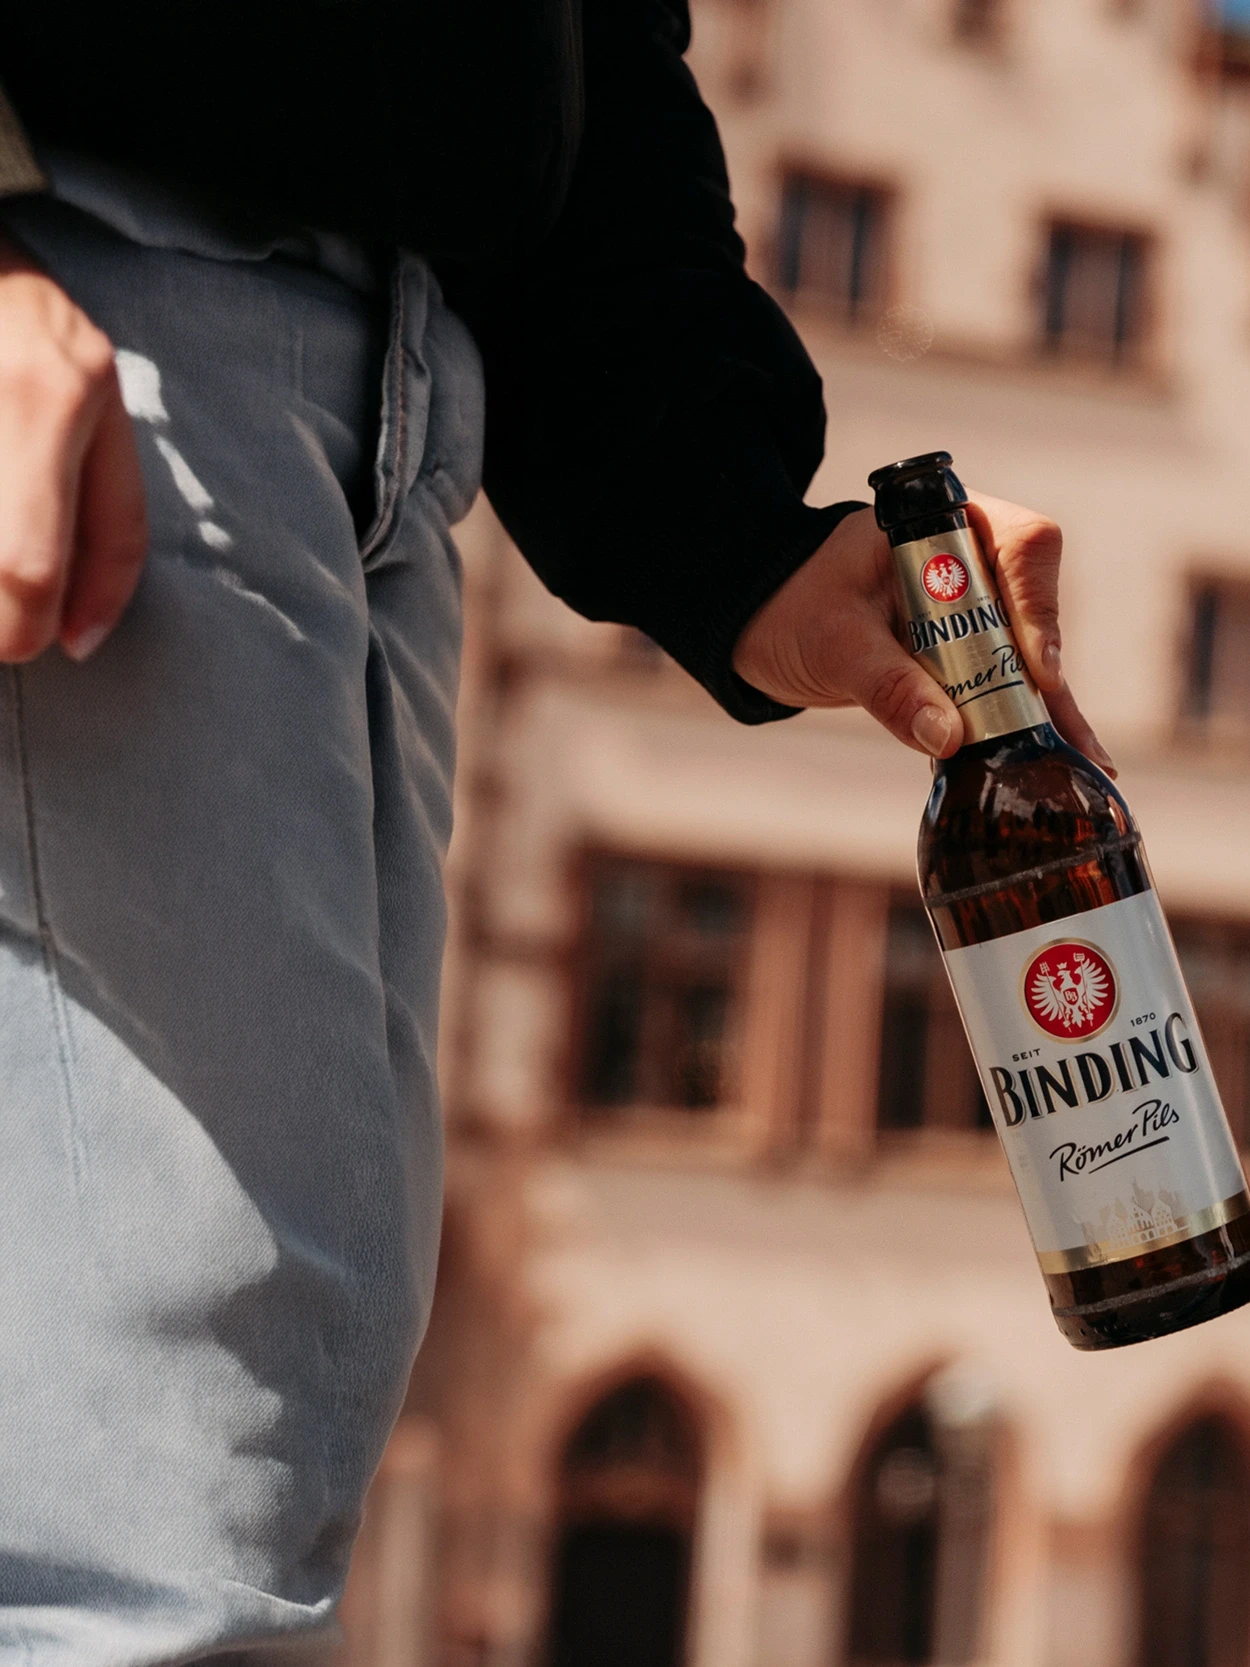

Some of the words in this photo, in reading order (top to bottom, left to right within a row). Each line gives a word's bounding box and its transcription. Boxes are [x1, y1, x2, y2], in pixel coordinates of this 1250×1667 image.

[992, 644, 1027, 678] Pil
[989, 1012, 1200, 1128] BINDING
[1012, 1047, 1041, 1062] SEIT
[1130, 1011, 1157, 1027] 1870
[1049, 1124, 1139, 1182] Römer
[1132, 1099, 1180, 1138] Pils
